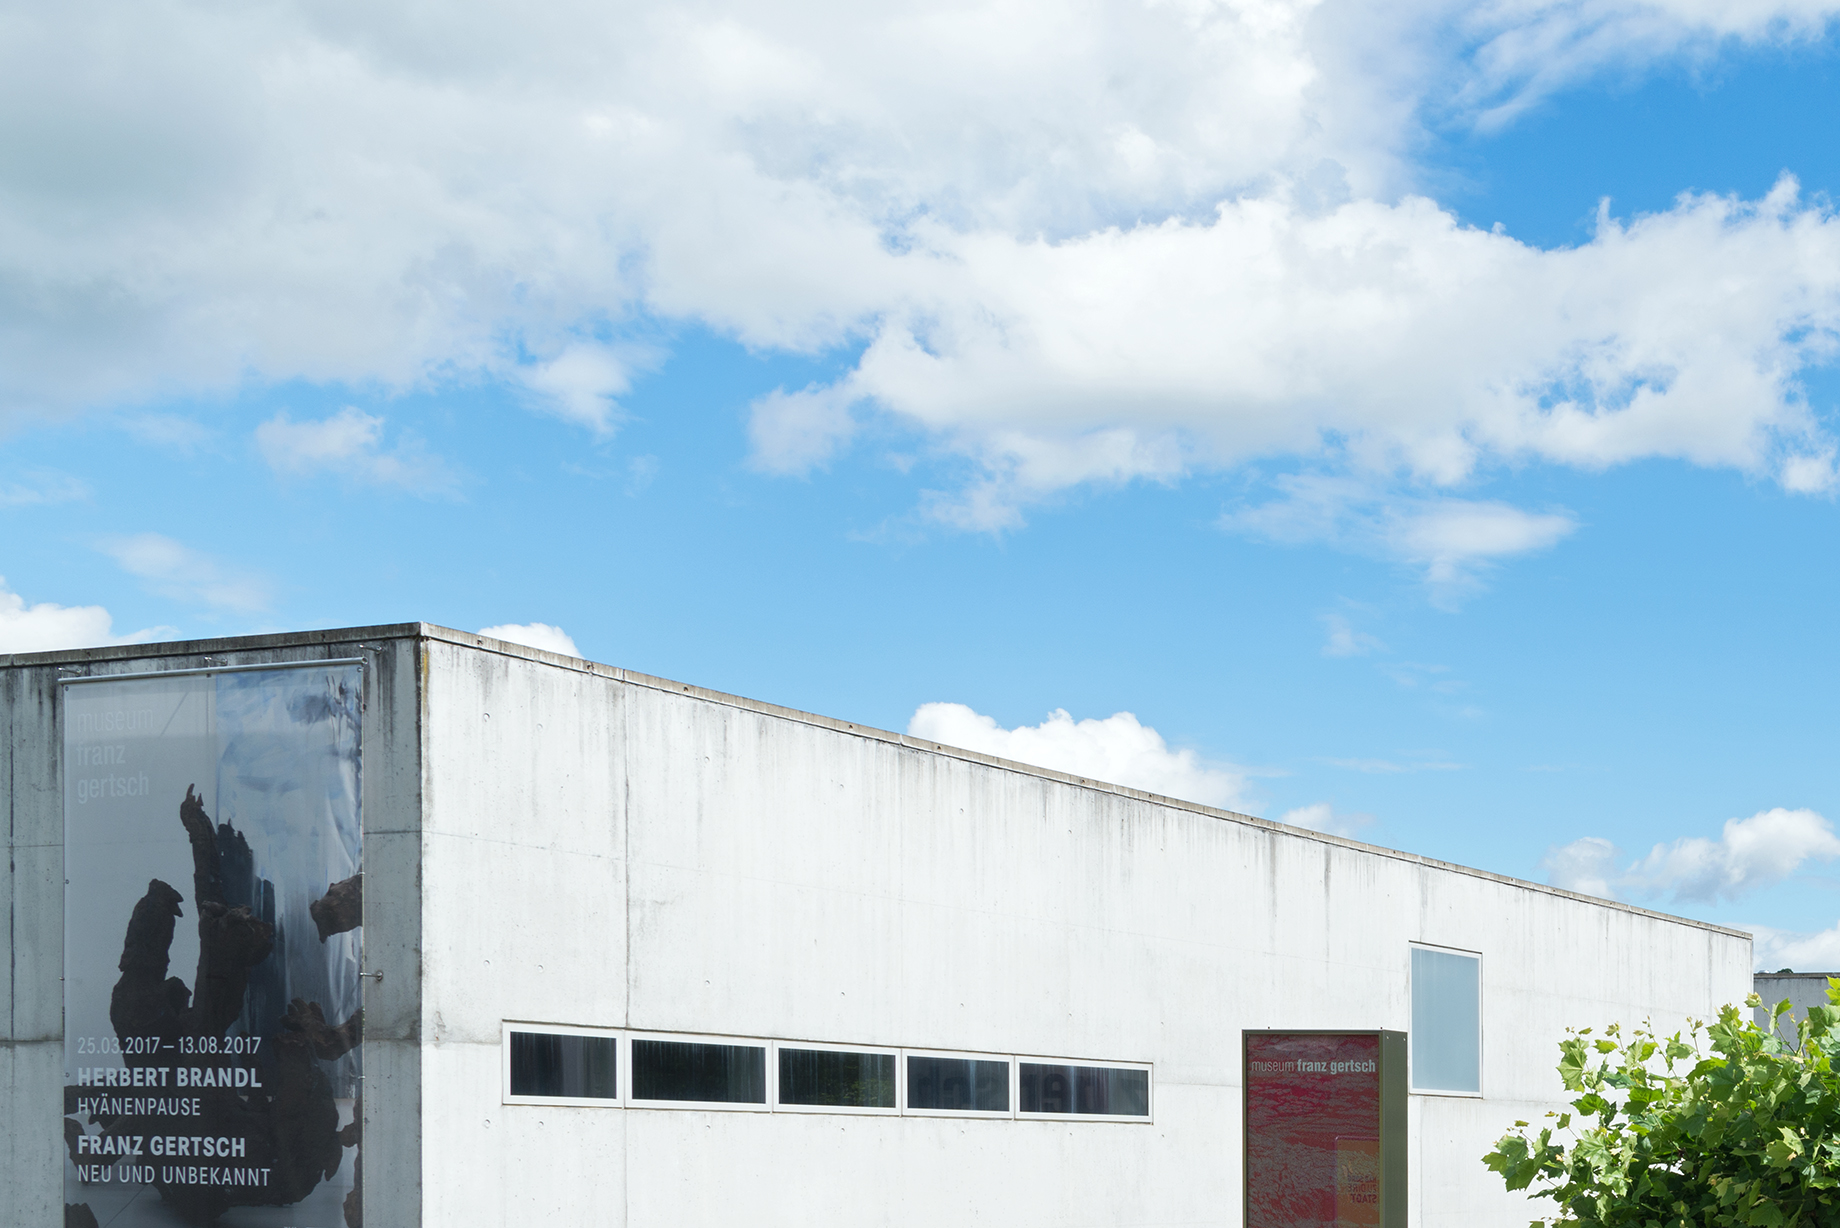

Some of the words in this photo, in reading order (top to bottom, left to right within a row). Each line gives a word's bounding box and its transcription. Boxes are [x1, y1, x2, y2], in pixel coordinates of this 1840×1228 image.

[77, 709, 154, 732] museum
[76, 741, 126, 766] franz
[77, 770, 149, 804] gertsch
[77, 1036, 160, 1054] 25.03.2017
[178, 1036, 262, 1054] 13.08.2017
[77, 1067, 170, 1087] HERBERT
[176, 1067, 262, 1088] BRANDL
[1251, 1060, 1295, 1072] museum
[1297, 1058, 1327, 1072] franz
[1330, 1059, 1376, 1075] gertsch
[77, 1092, 201, 1116] HYÄNENPAUSE
[77, 1135, 144, 1156] FRANZ
[150, 1135, 246, 1158] GERTSCH
[77, 1164, 112, 1183] NEU
[119, 1165, 156, 1184] UND
[162, 1166, 271, 1187] UNBEKANNT
